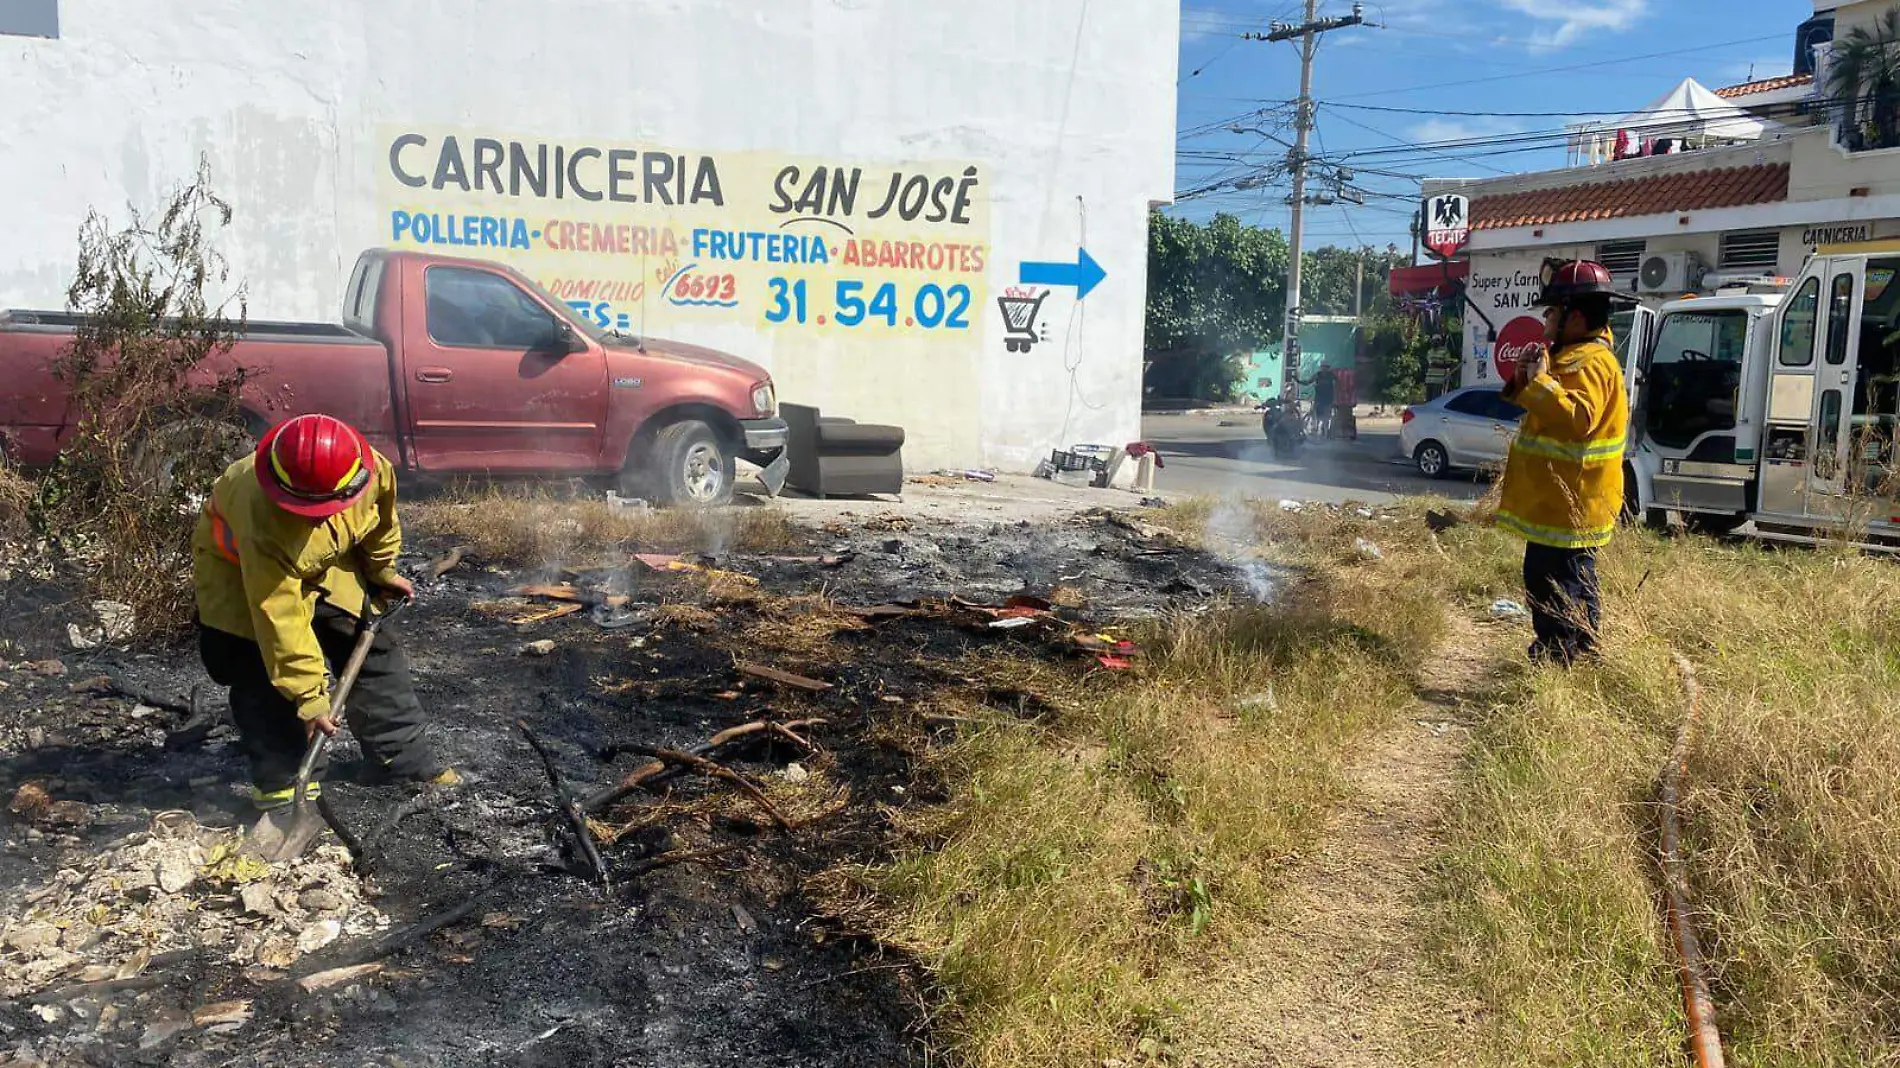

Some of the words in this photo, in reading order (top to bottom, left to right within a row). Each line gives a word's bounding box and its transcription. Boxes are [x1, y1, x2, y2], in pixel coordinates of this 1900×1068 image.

[389, 133, 724, 206] CARNICERIA
[769, 165, 862, 216] SAN
[867, 165, 978, 224] JOSÉ
[1428, 229, 1467, 246] TECATE
[1803, 226, 1866, 245] CARNICERIA
[550, 278, 645, 301] DOMICILIO
[675, 273, 736, 300] 6693
[1472, 273, 1503, 292] Super
[1504, 277, 1513, 289] y
[1494, 293, 1520, 308] SAN
[1523, 292, 1541, 307] JO
